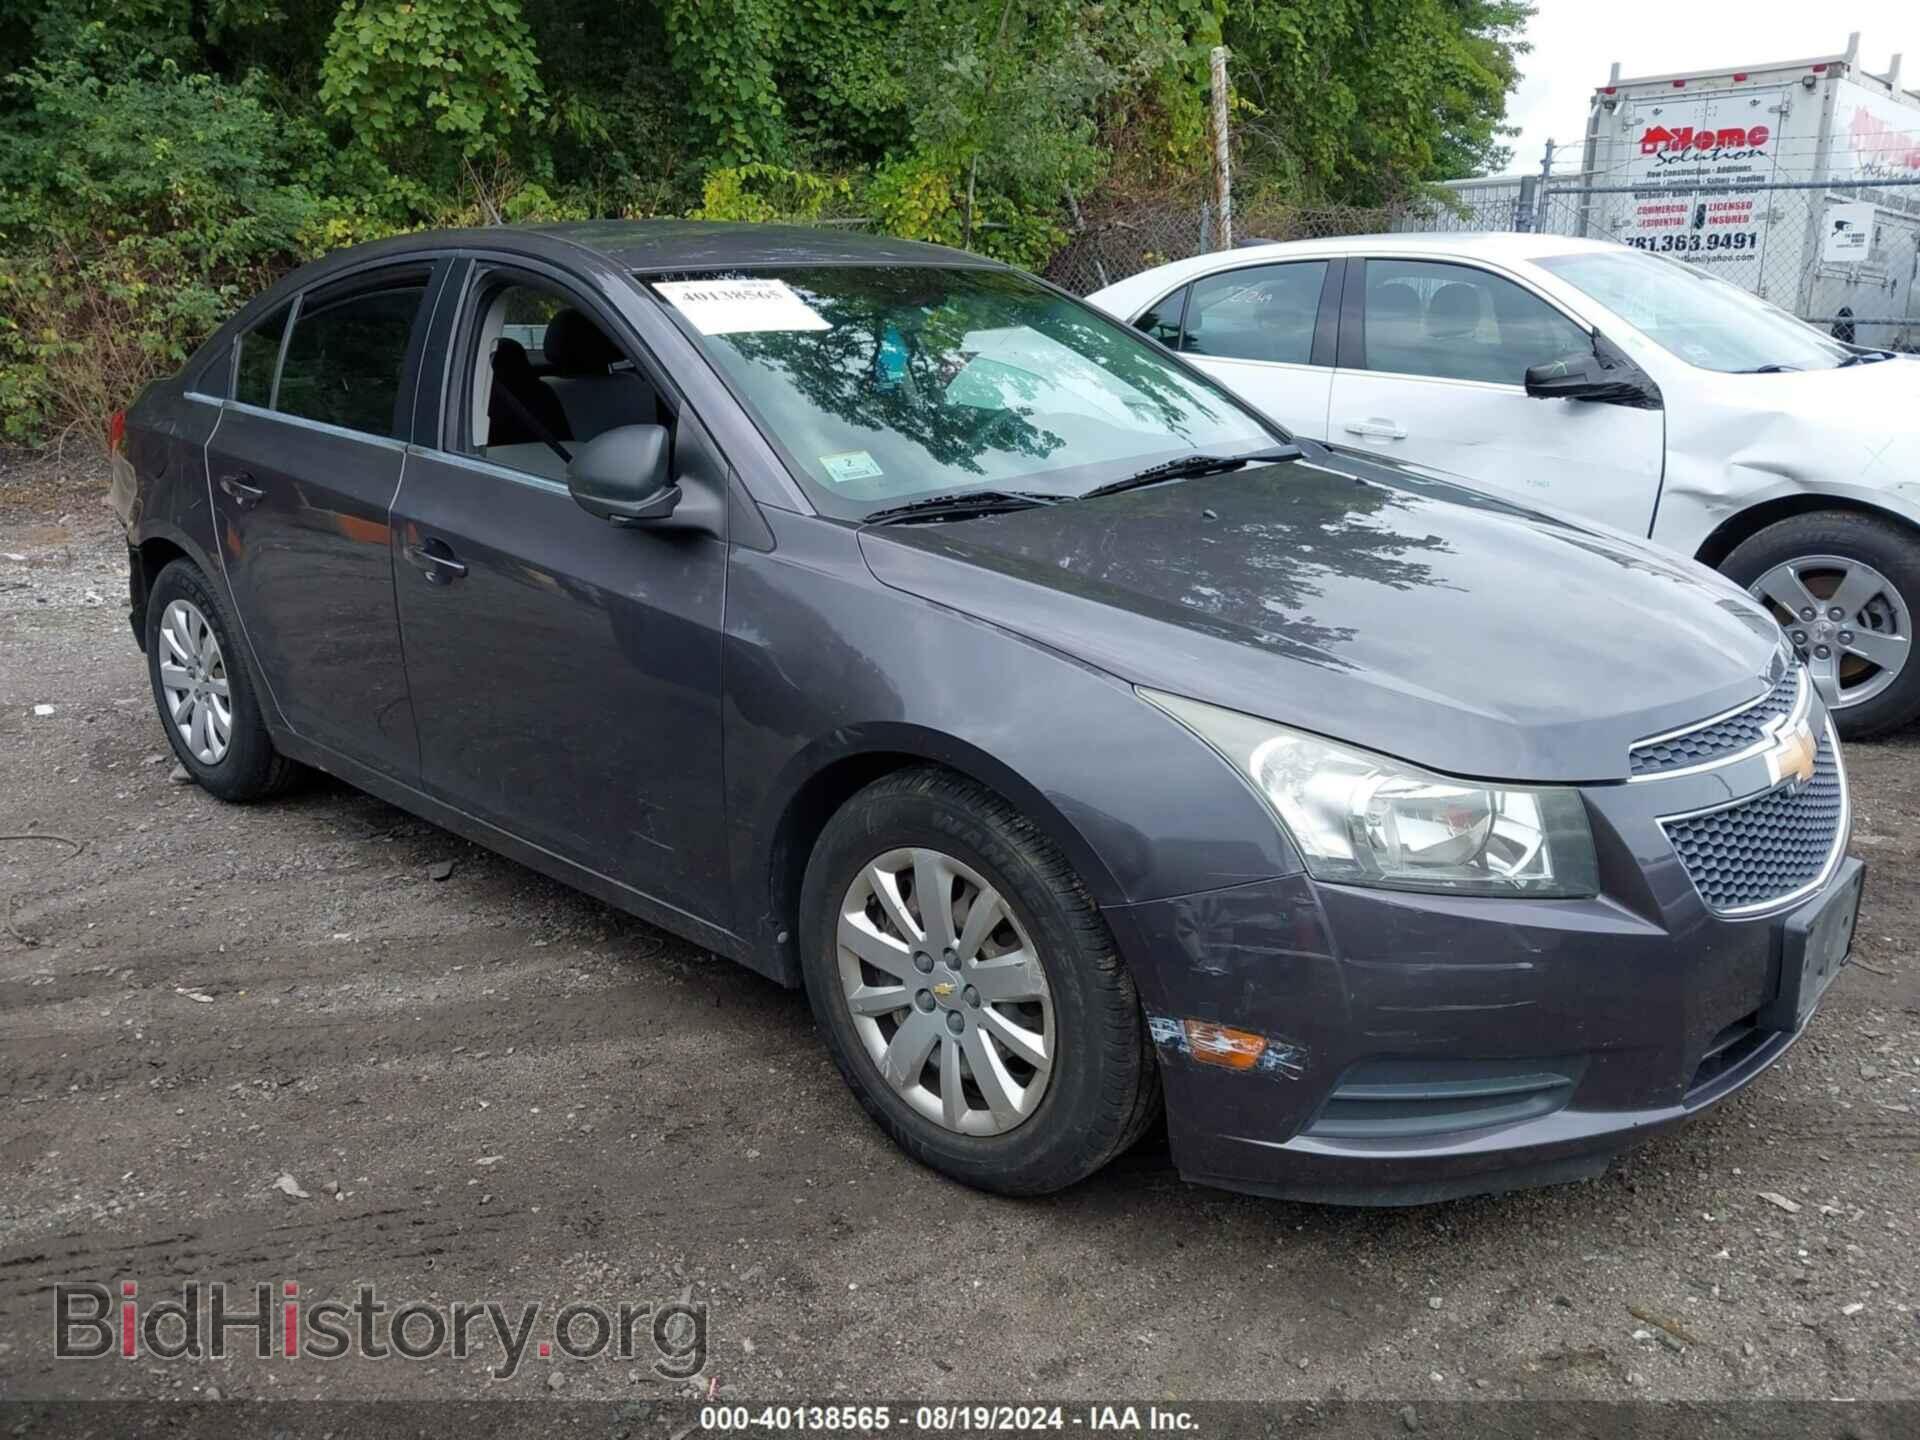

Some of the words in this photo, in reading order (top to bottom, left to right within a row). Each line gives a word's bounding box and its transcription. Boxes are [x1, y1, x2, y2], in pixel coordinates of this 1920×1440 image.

[1655, 146, 1767, 167] Solution
[1663, 168, 1711, 177] Construction
[1708, 201, 1753, 211] LICENSED
[1708, 215, 1750, 225] INSURED
